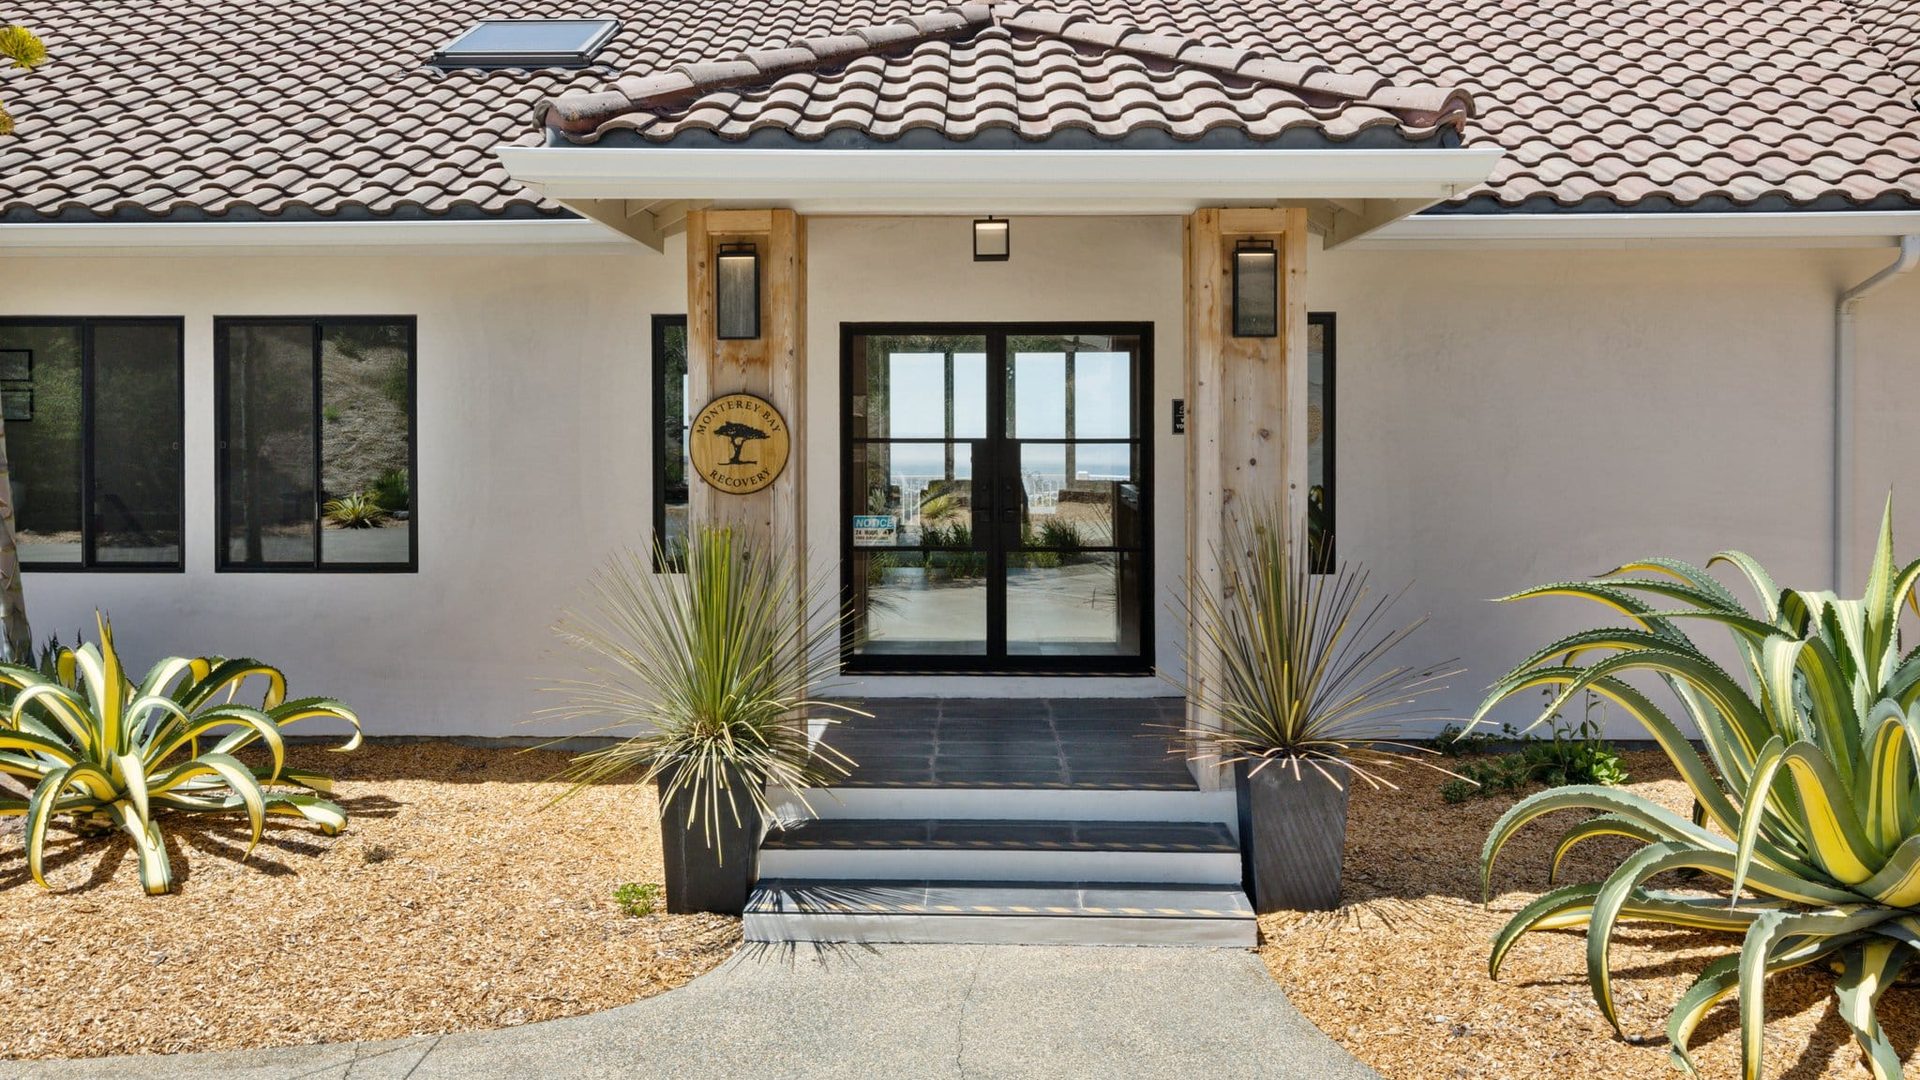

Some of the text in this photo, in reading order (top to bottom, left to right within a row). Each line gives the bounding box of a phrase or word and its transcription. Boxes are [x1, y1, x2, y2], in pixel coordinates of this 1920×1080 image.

[696, 400, 781, 435] MONTEREY BAY
[709, 467, 771, 488] RECOVERY
[855, 518, 894, 528] NOTICE
